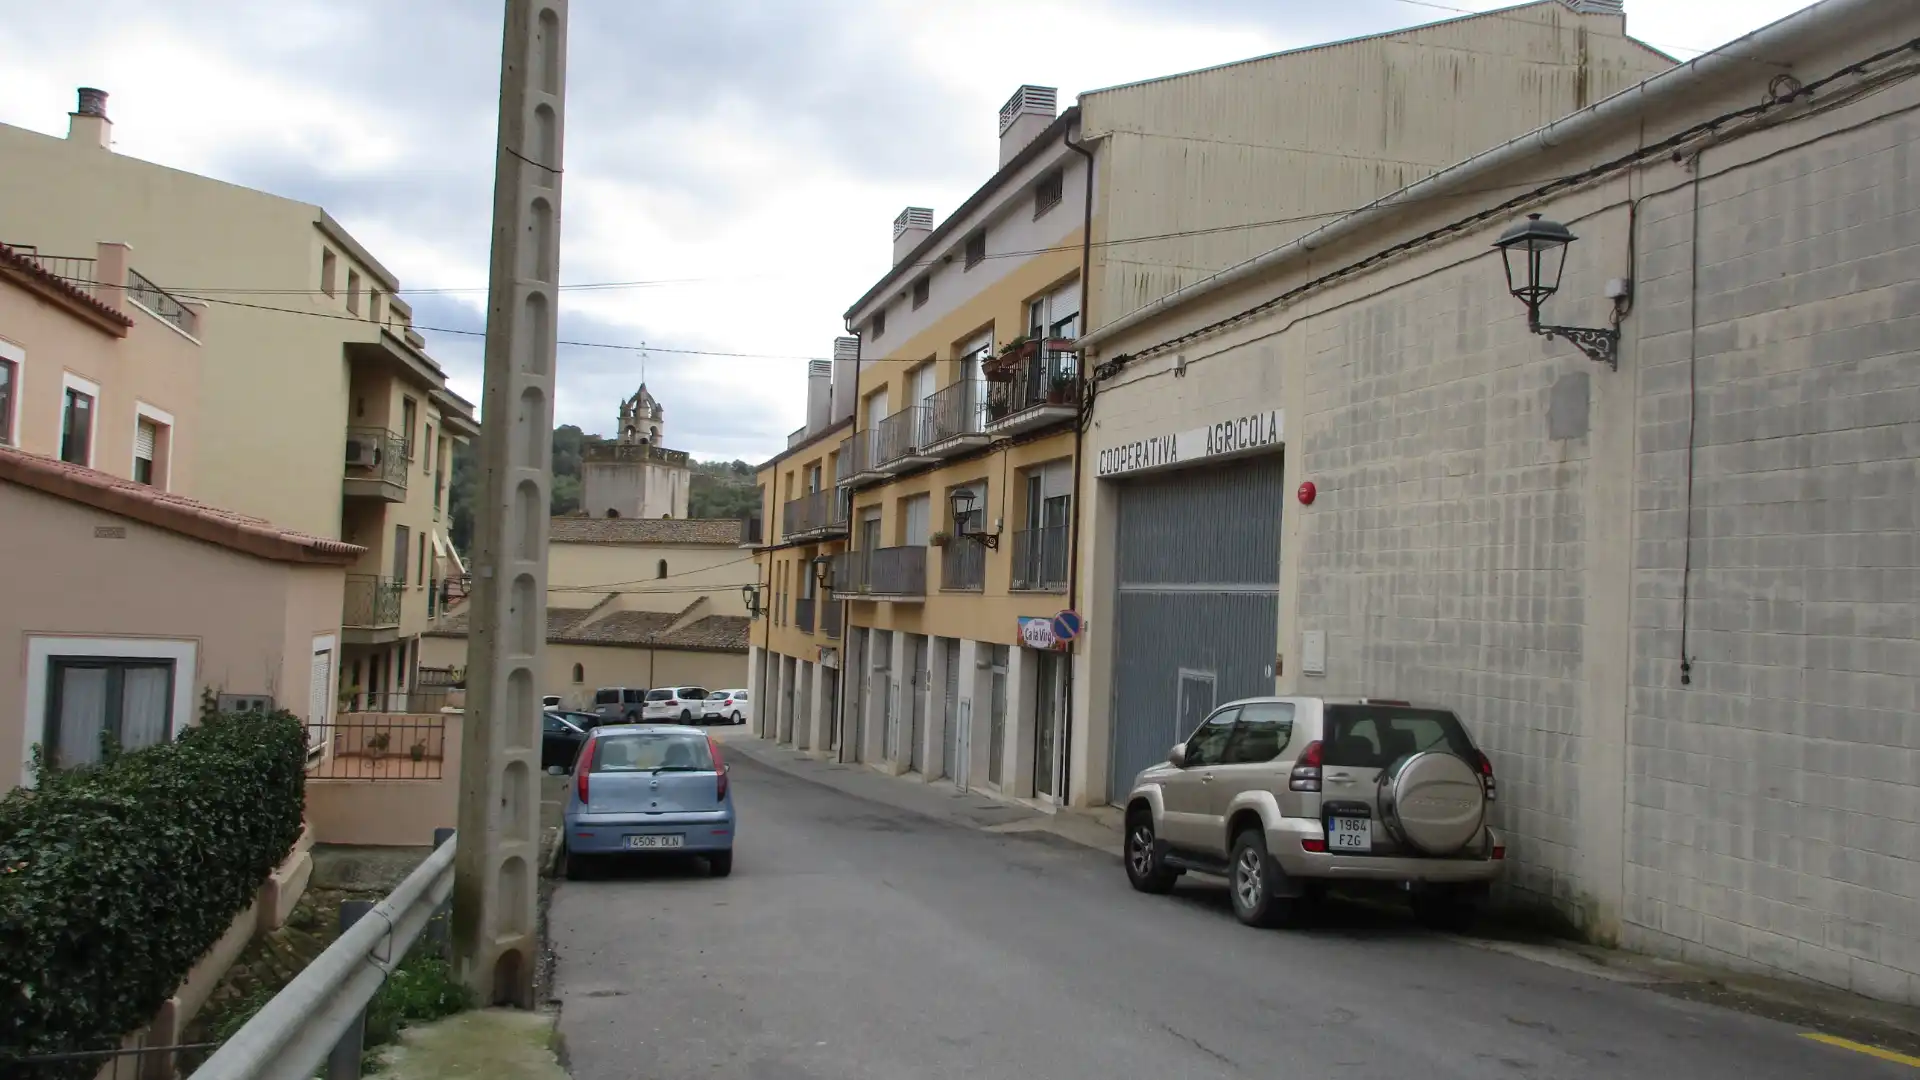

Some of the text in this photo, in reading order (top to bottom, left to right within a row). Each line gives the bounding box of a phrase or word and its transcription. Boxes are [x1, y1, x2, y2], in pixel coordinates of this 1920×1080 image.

[1099, 433, 1177, 475] COOPERATIVA
[1339, 819, 1367, 832] 1964
[632, 836, 656, 847] 4506
[1339, 834, 1361, 846] FZG
